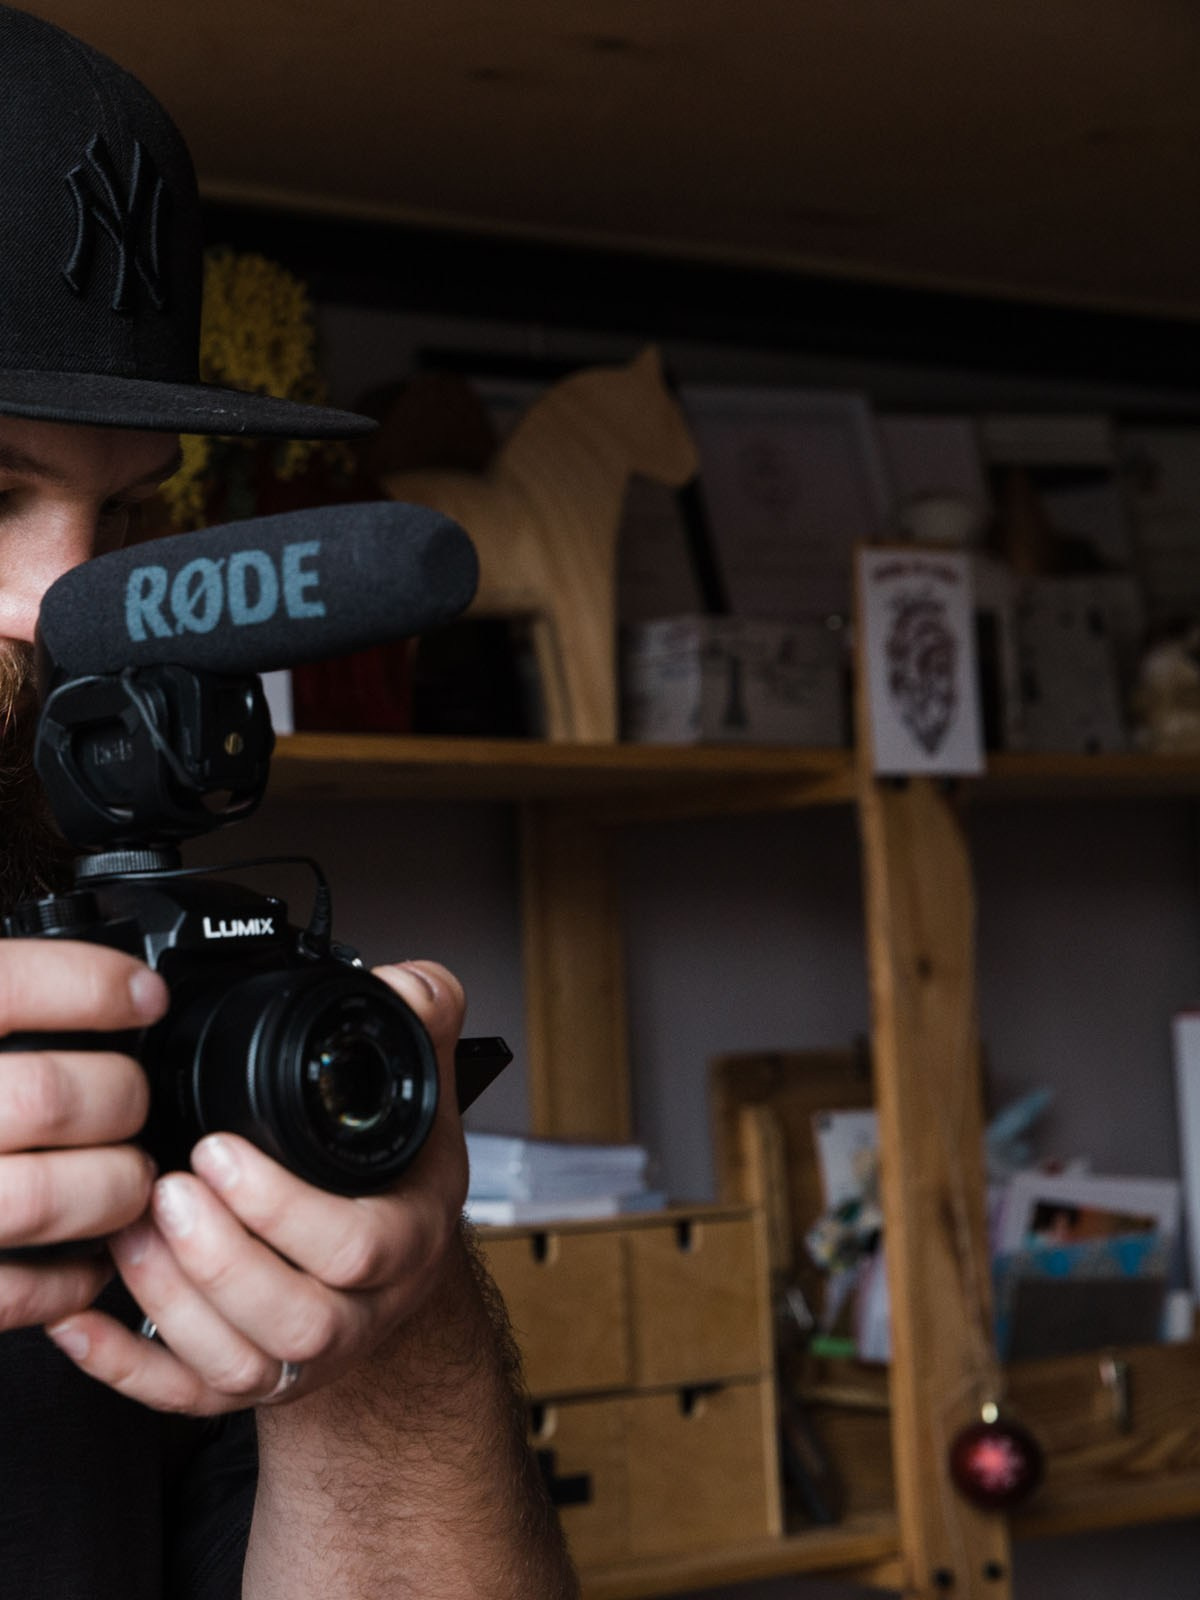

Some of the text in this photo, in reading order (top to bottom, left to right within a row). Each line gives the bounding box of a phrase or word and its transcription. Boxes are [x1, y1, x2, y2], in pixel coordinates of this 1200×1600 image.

[62, 132, 170, 312] NY
[125, 540, 326, 642] RØDE
[202, 915, 275, 939] LUMIX
